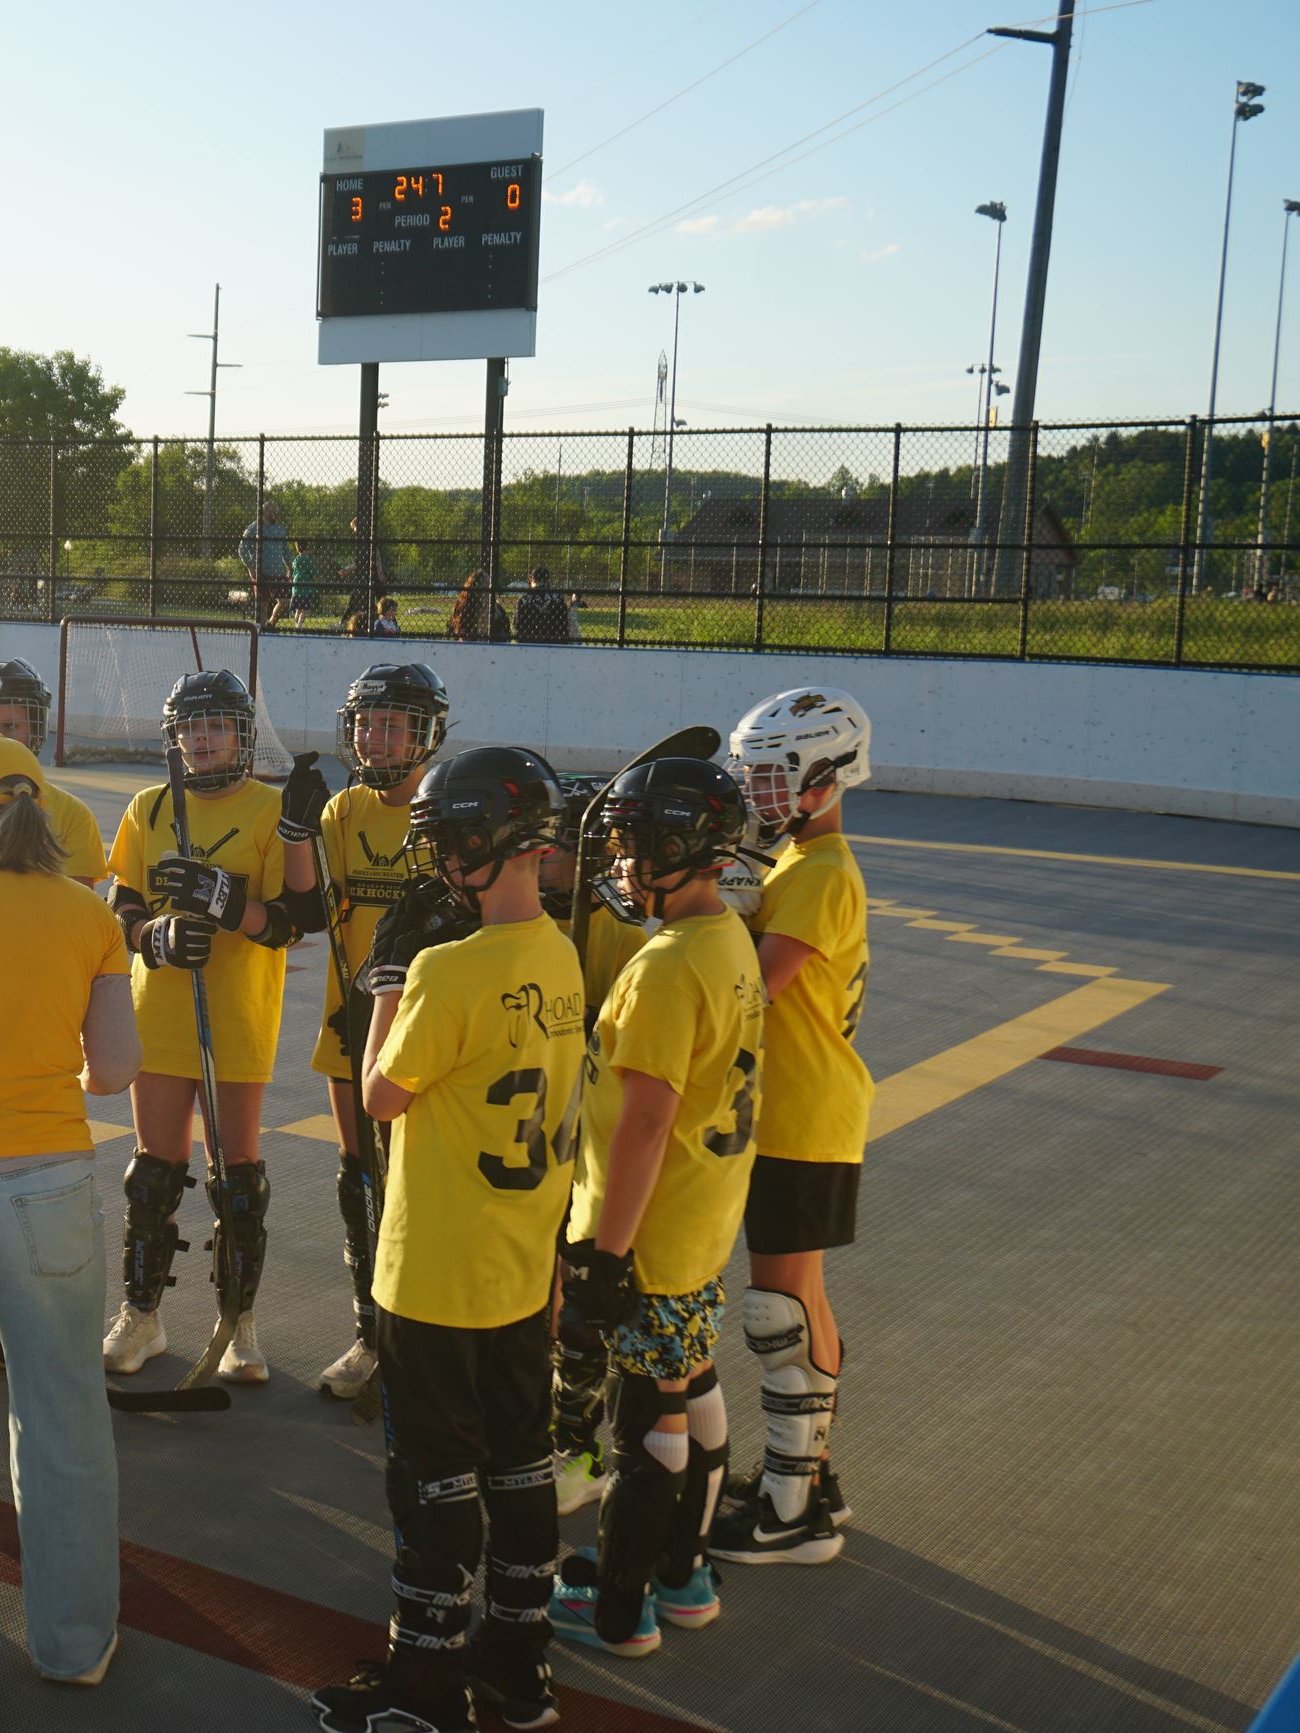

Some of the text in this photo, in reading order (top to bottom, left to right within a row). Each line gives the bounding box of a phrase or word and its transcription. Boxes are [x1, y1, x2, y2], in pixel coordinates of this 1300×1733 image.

[491, 165, 523, 178] GUEST
[336, 178, 364, 191] HOME
[507, 184, 520, 209] 0
[351, 197, 363, 222] 3
[395, 206, 452, 231] PERIOD 2
[328, 239, 411, 255] PLAYER PENALTY
[433, 232, 522, 249] PLAYER PENALTY
[452, 801, 479, 809] CCM
[664, 808, 691, 817] CCM
[718, 875, 762, 888] KNAPP
